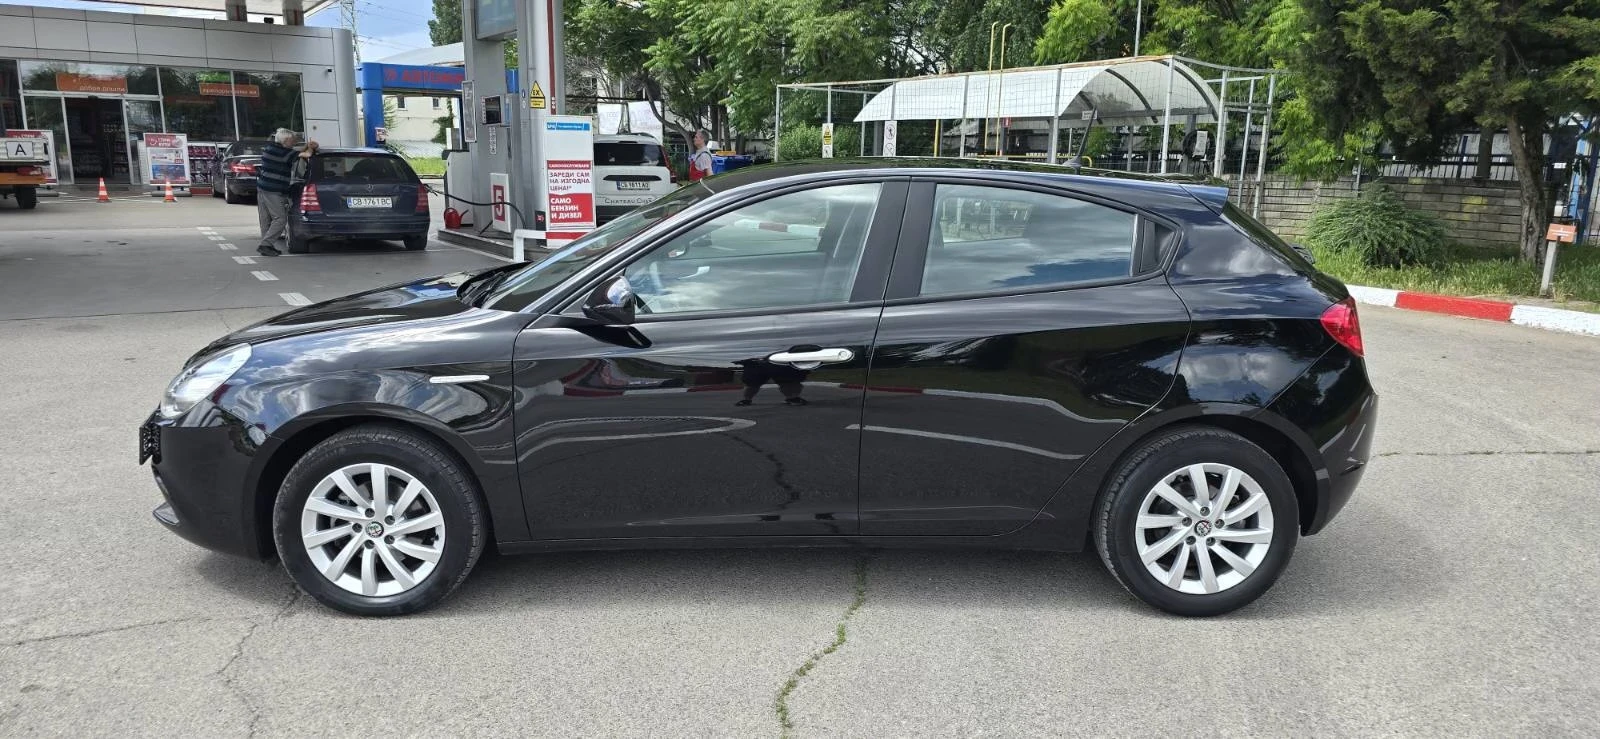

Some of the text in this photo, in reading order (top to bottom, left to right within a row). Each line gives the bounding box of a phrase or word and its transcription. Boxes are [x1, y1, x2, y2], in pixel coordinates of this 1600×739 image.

[532, 89, 541, 97] EX
[494, 191, 504, 217] 5
[550, 197, 572, 205] САМО
[558, 212, 582, 220] ДИЗЕЛ
